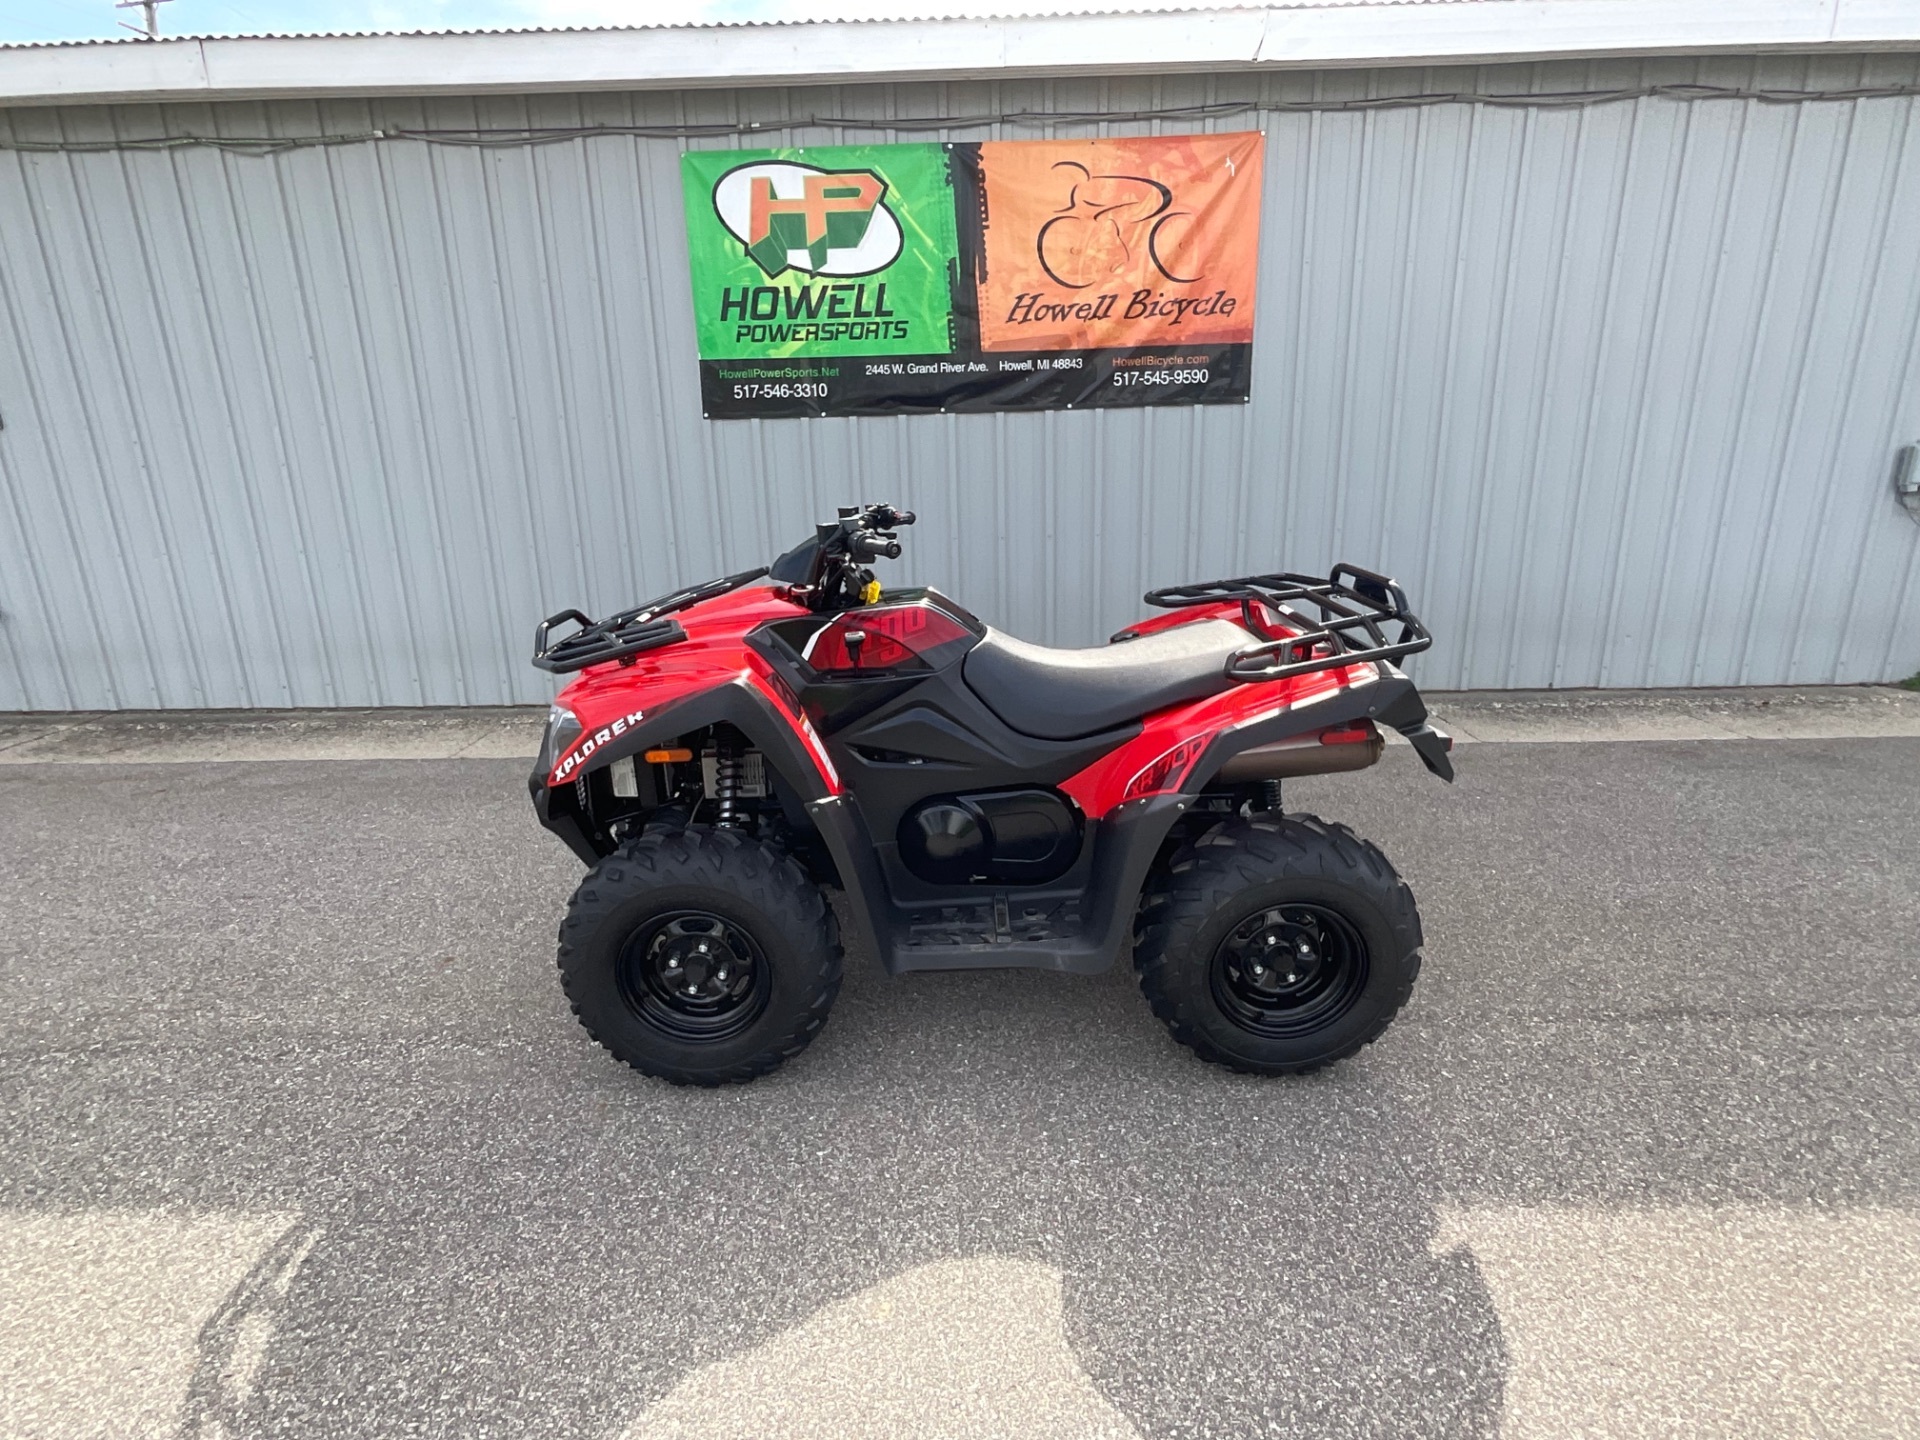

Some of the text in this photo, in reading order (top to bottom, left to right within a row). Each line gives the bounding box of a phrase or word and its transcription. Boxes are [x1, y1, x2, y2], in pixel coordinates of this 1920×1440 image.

[750, 173, 885, 252] HP
[720, 283, 894, 321] HOWELL
[1005, 288, 1237, 326] Howell Bicycle
[736, 320, 909, 343] POWERSPORTS
[865, 358, 1083, 375] 2445 W. Grand River Ave. Howell, MI 48843
[1112, 354, 1209, 367] HowellBicycle.com
[719, 367, 840, 379] HowellPowerSports.Net
[1113, 369, 1209, 386] 517-545-9590
[734, 383, 828, 399] 517-546-3310
